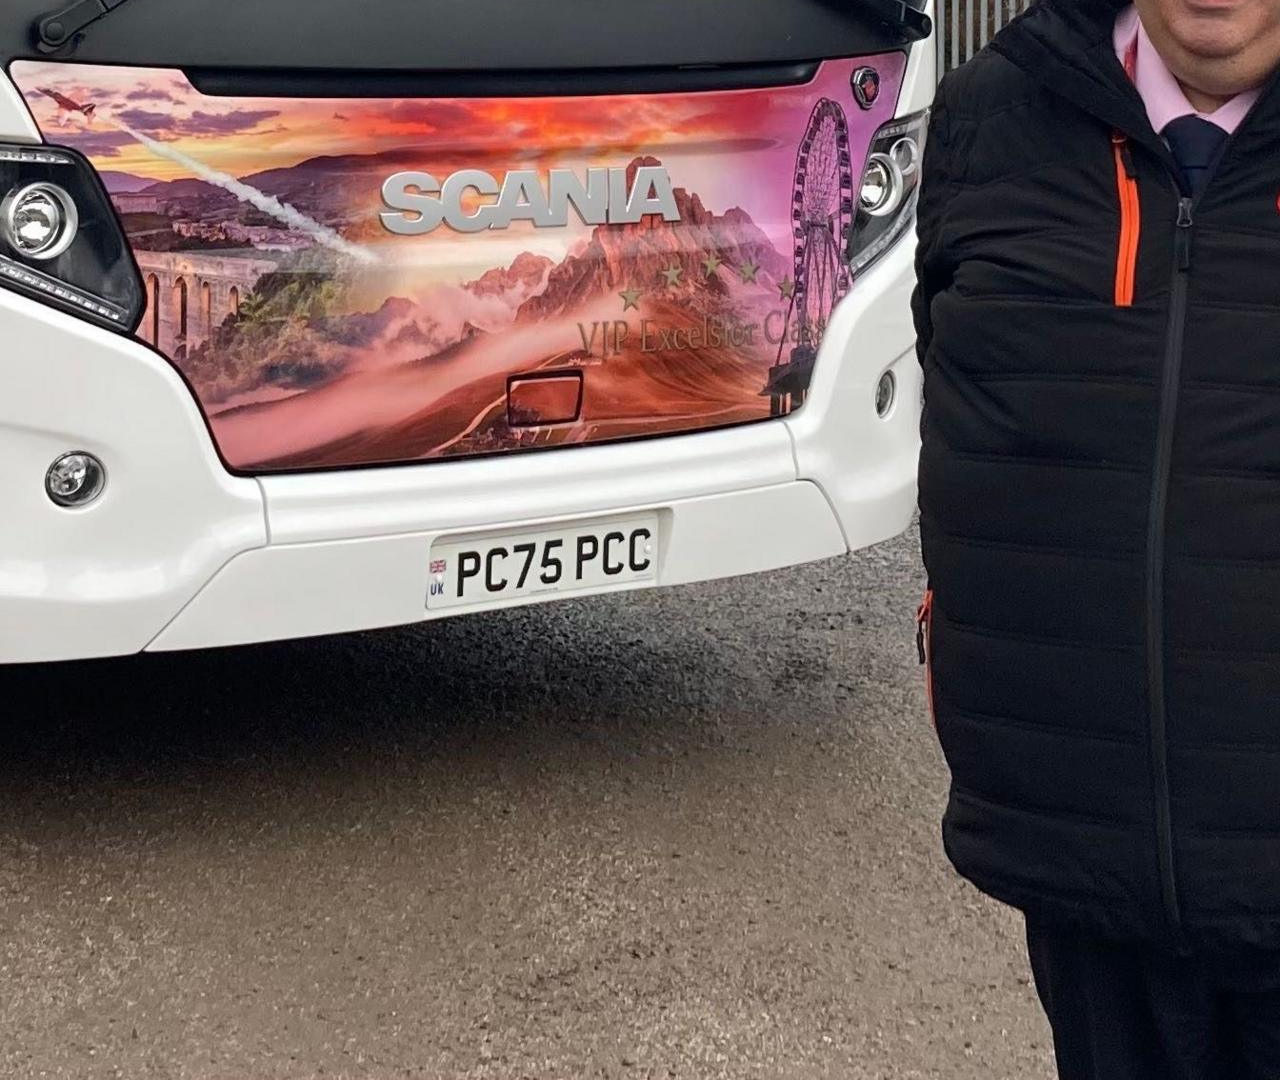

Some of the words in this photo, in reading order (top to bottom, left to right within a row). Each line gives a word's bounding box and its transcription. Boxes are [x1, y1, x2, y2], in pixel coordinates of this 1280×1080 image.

[378, 166, 682, 236] SCANIA
[577, 320, 630, 356] VIP
[640, 314, 761, 353] Excelsior
[430, 582, 444, 596] UK
[456, 539, 563, 597] PC75
[576, 528, 651, 580] PCC
